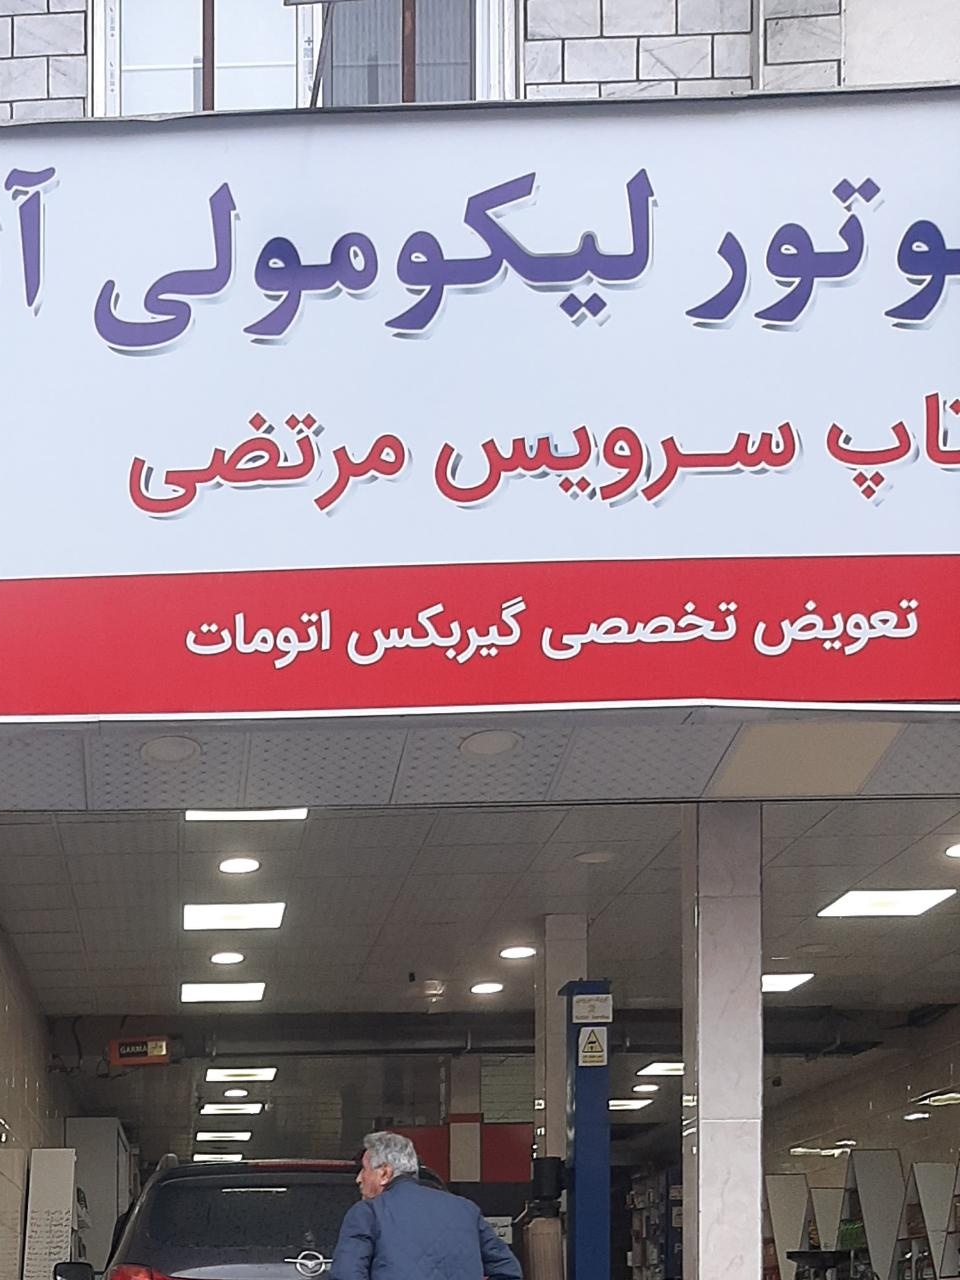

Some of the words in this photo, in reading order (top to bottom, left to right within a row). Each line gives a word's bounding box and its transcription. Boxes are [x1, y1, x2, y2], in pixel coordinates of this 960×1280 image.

[683, 175, 960, 328] وتور
[128, 410, 411, 516] مرتضی
[434, 416, 800, 507] سرویس
[184, 609, 331, 670] اتومات
[347, 596, 525, 666] گیربکس
[541, 600, 739, 662] تخصصی
[752, 598, 920, 656] تعویض
